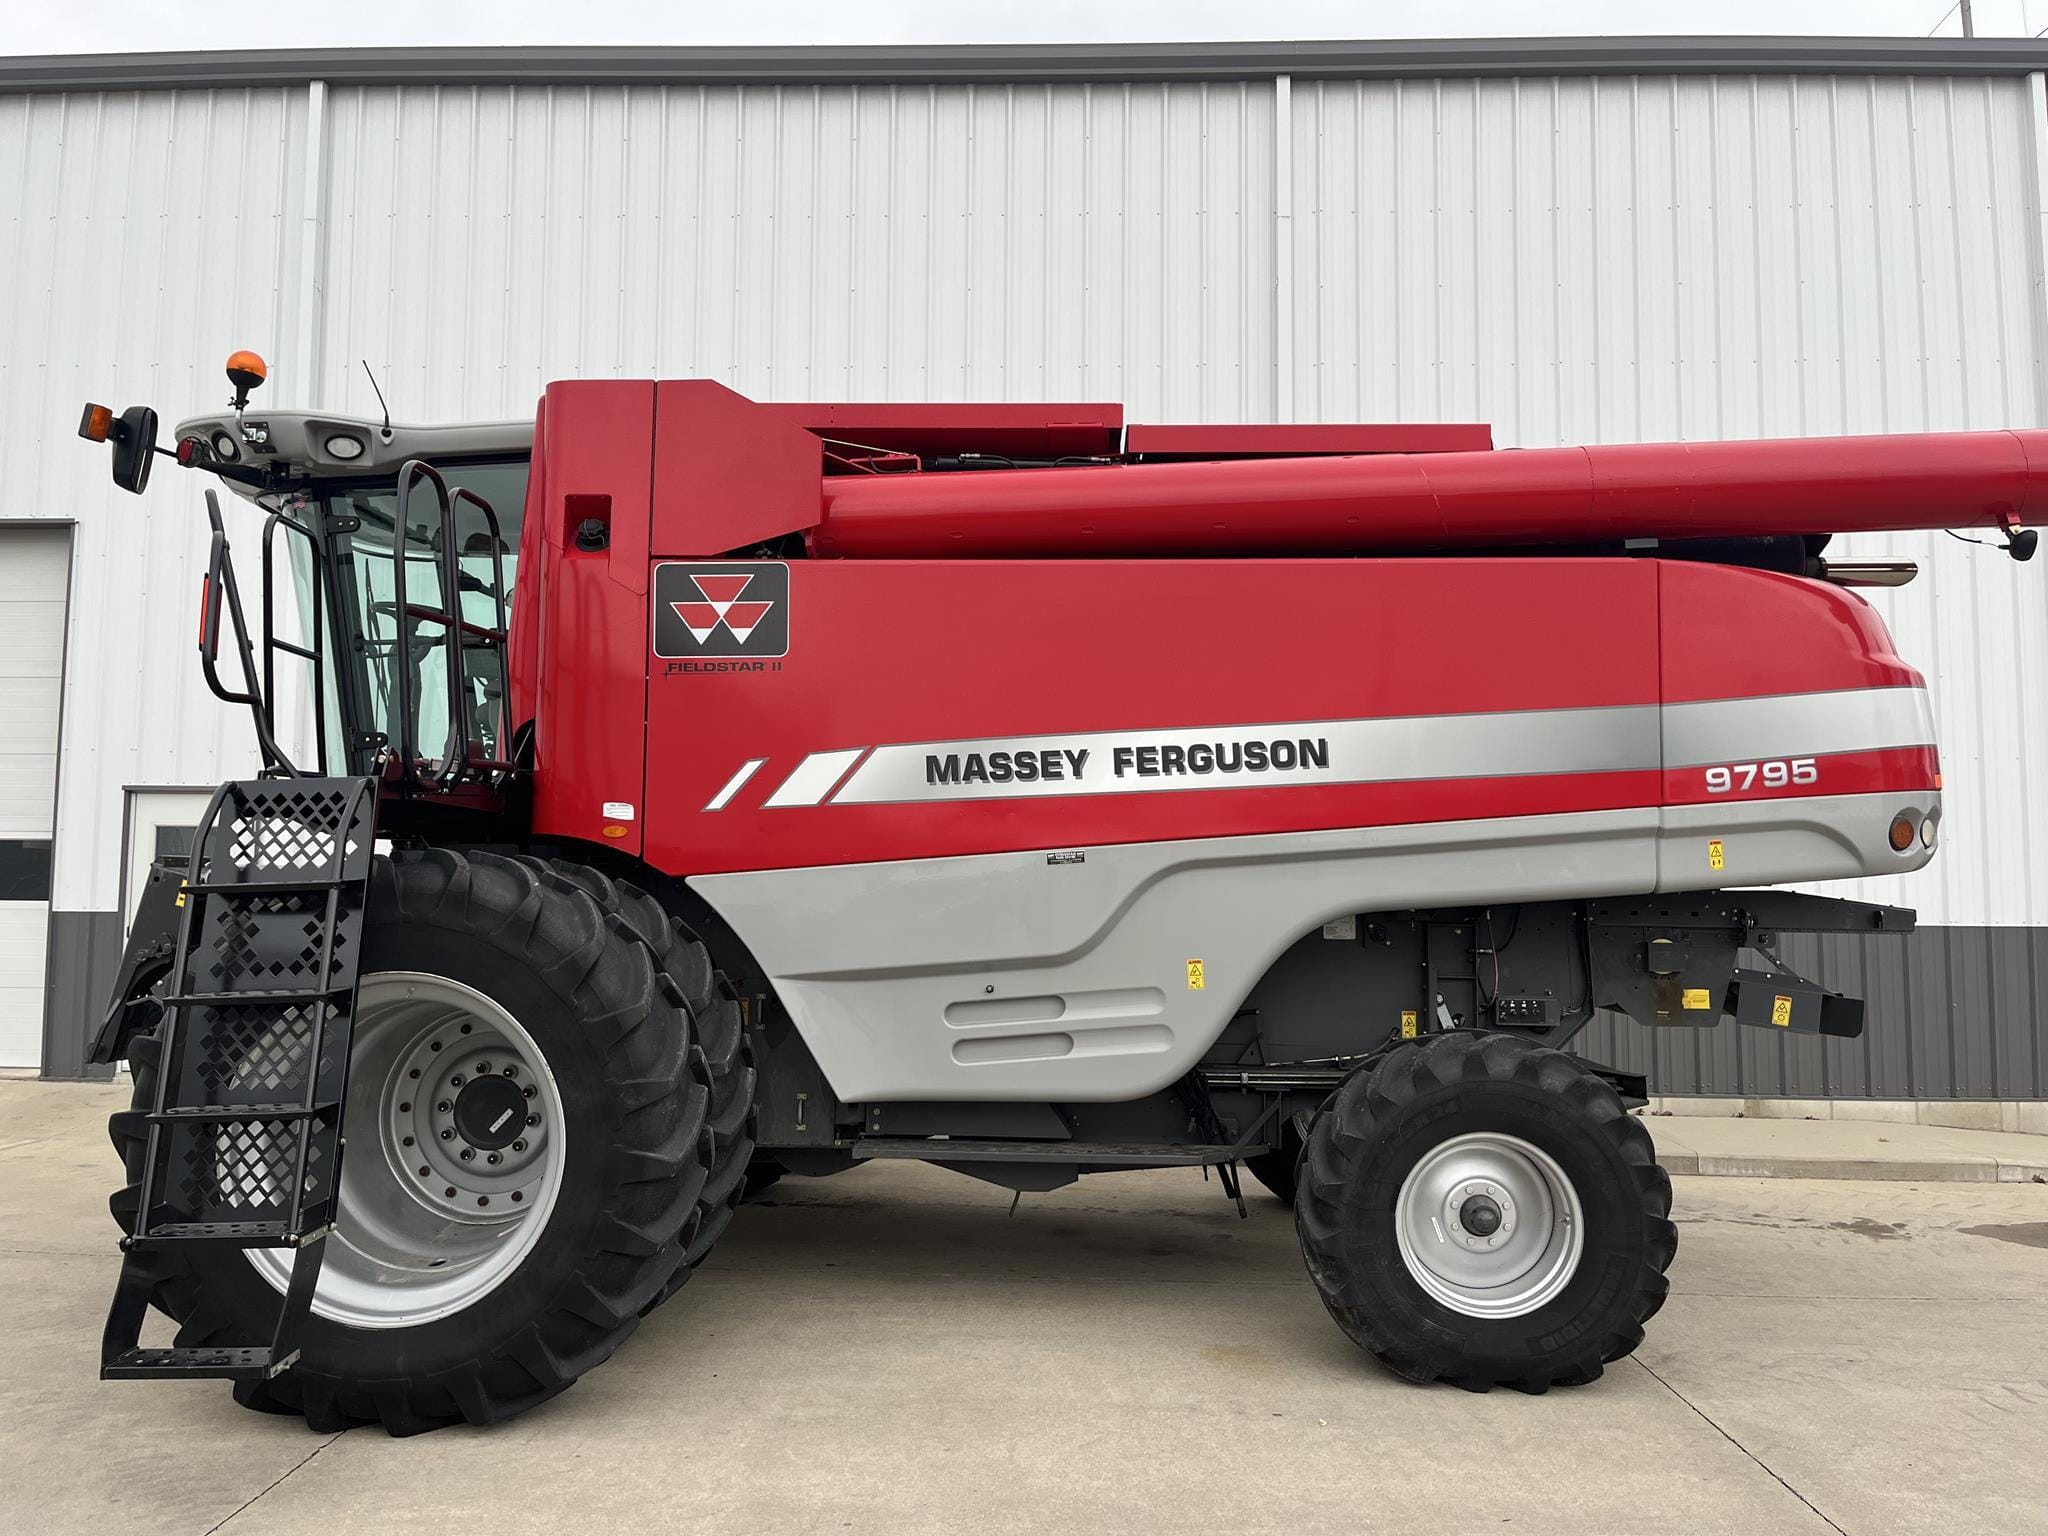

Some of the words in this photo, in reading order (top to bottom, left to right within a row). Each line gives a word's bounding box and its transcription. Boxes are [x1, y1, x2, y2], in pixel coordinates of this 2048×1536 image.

[668, 662, 764, 672] FIELDSTAR
[925, 749, 1090, 785] MASSEY
[1113, 738, 1330, 777] FERGUSON
[1706, 759, 1817, 793] 9795
